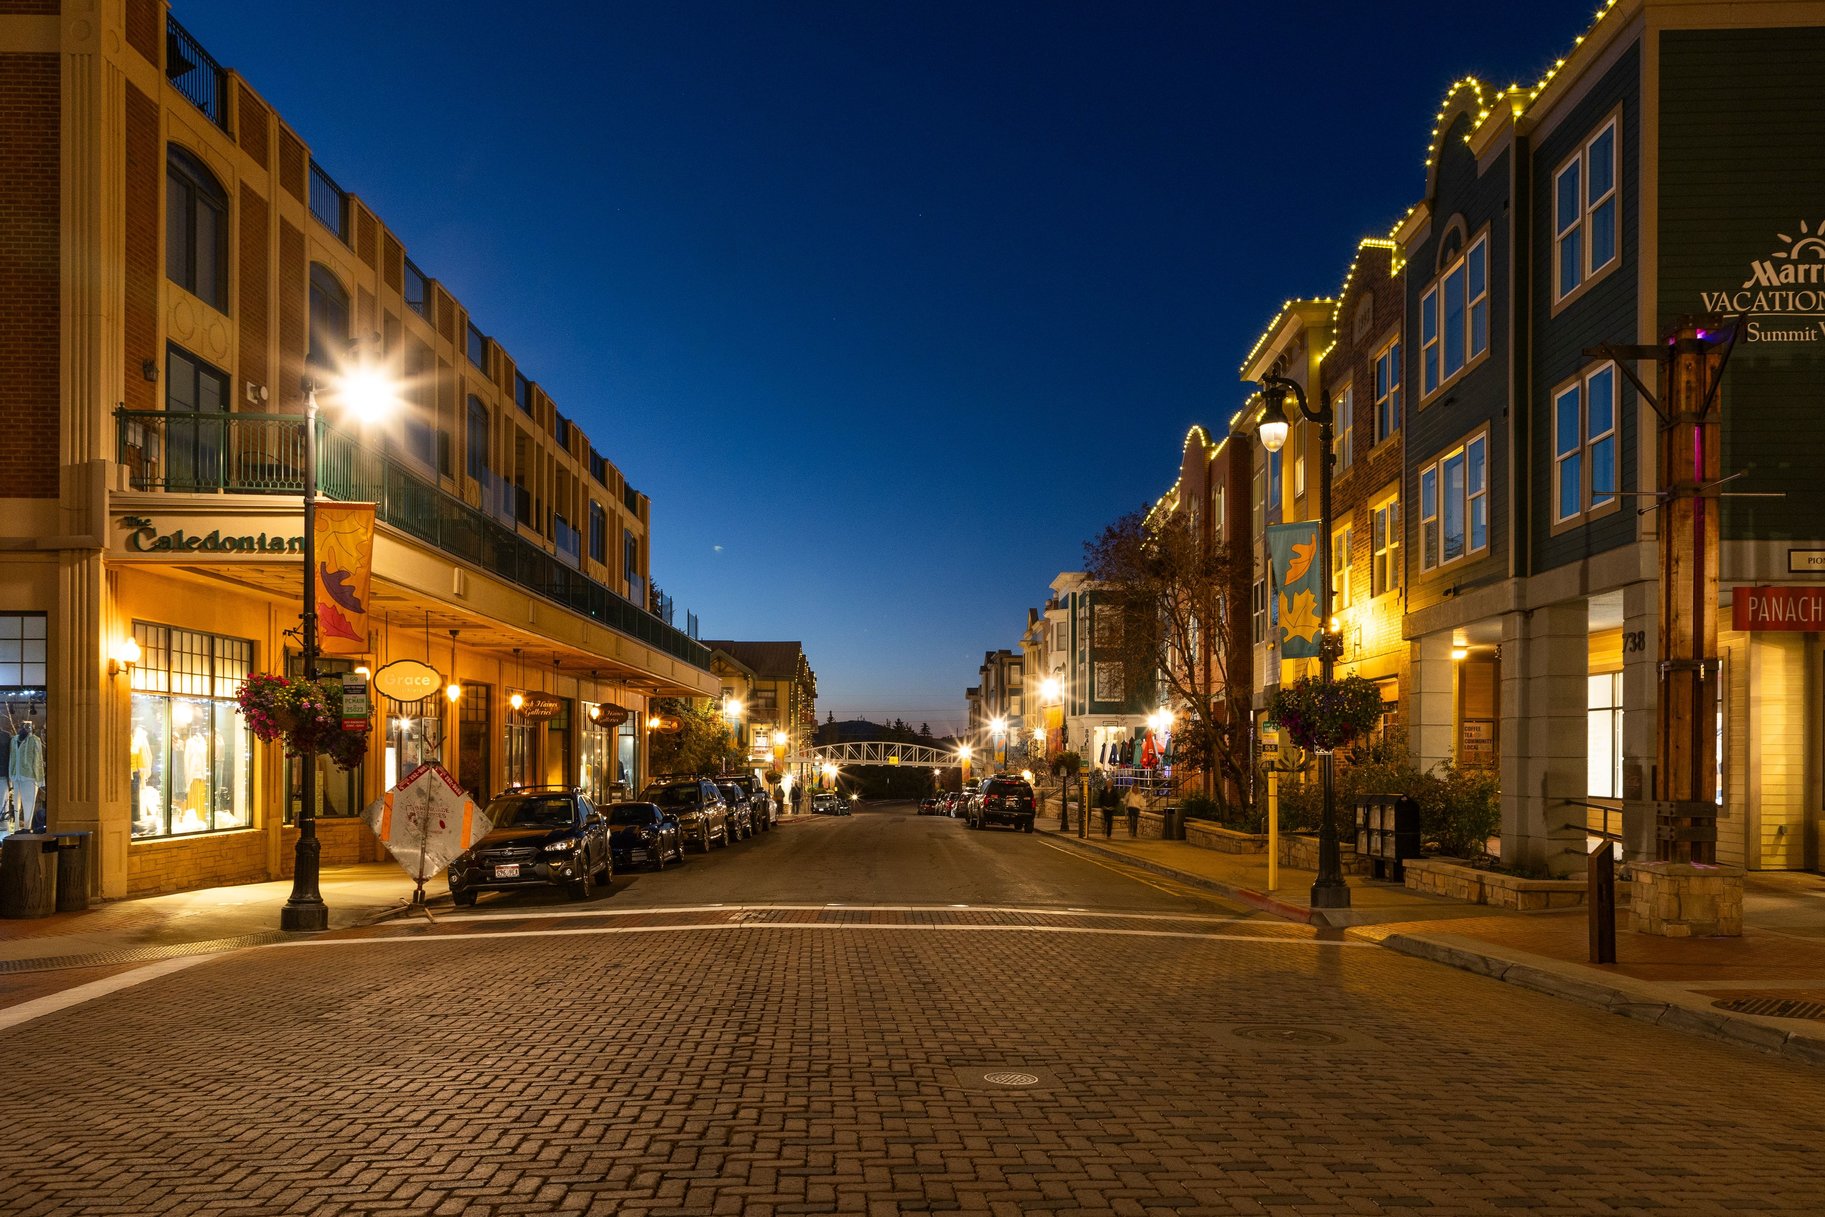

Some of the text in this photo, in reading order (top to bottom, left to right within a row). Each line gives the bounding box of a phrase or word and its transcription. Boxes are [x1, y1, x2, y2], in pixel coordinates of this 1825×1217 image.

[1742, 260, 1825, 288] Marr
[1747, 322, 1818, 342] Summit
[125, 515, 152, 527] The
[133, 527, 305, 552] Caledonian
[1808, 557, 1825, 565] PIO
[1748, 596, 1822, 622] PANACH
[1622, 630, 1646, 653] 738
[385, 672, 431, 686] Grace
